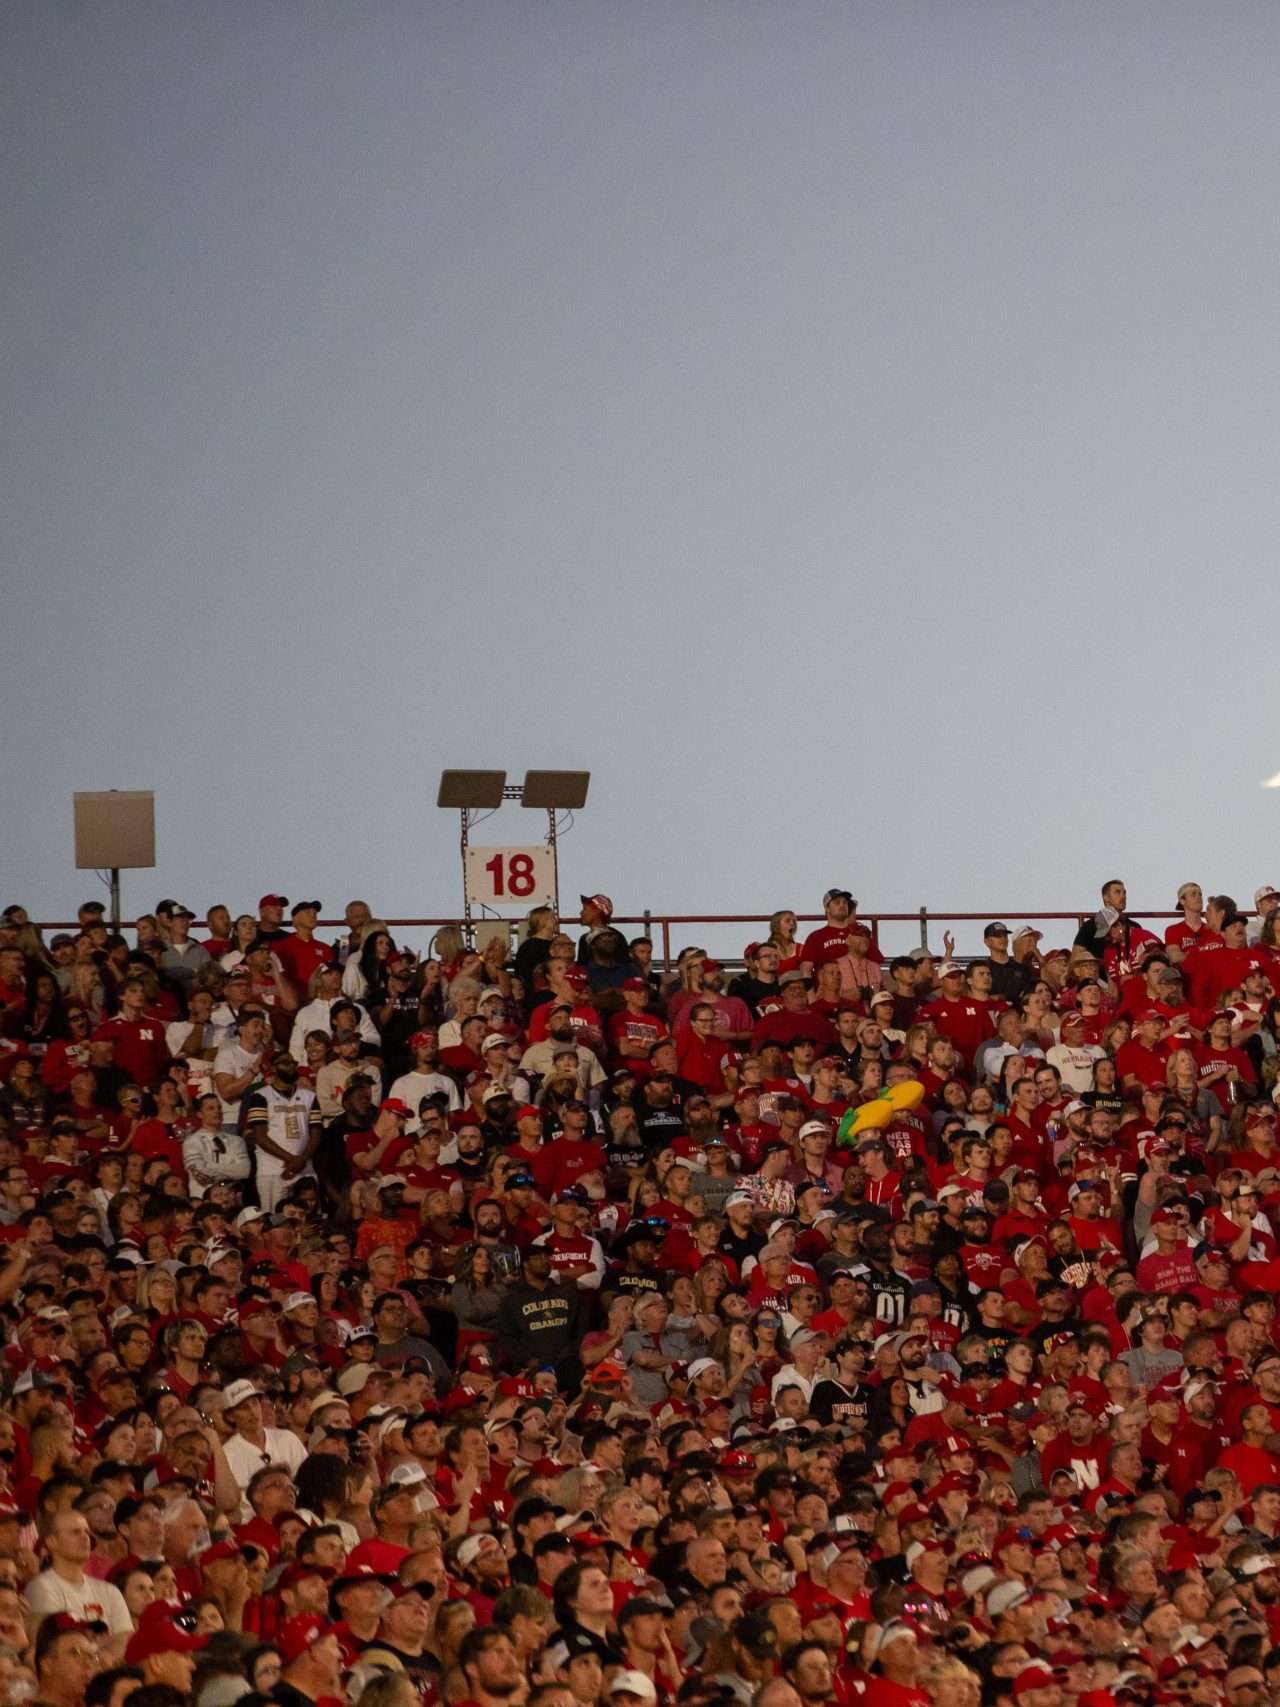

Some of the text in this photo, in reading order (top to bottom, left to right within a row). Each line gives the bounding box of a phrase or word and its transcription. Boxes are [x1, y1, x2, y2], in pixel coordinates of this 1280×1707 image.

[485, 853, 536, 897] 18
[1119, 959, 1131, 976] N
[965, 1006, 977, 1016] N
[139, 1028, 153, 1041] N
[906, 1116, 925, 1131] SKA
[886, 1131, 910, 1142] NEB
[1157, 1264, 1192, 1280] RUN THE
[619, 1275, 658, 1291] COLORADO
[1154, 1279, 1177, 1291] DAMN
[522, 1298, 570, 1316] COLORADO
[876, 1292, 906, 1326] 01
[1220, 1436, 1231, 1447] N
[1177, 1448, 1187, 1457] N
[737, 1455, 748, 1465] N
[1071, 1458, 1101, 1491] N
[494, 1499, 505, 1513] N
